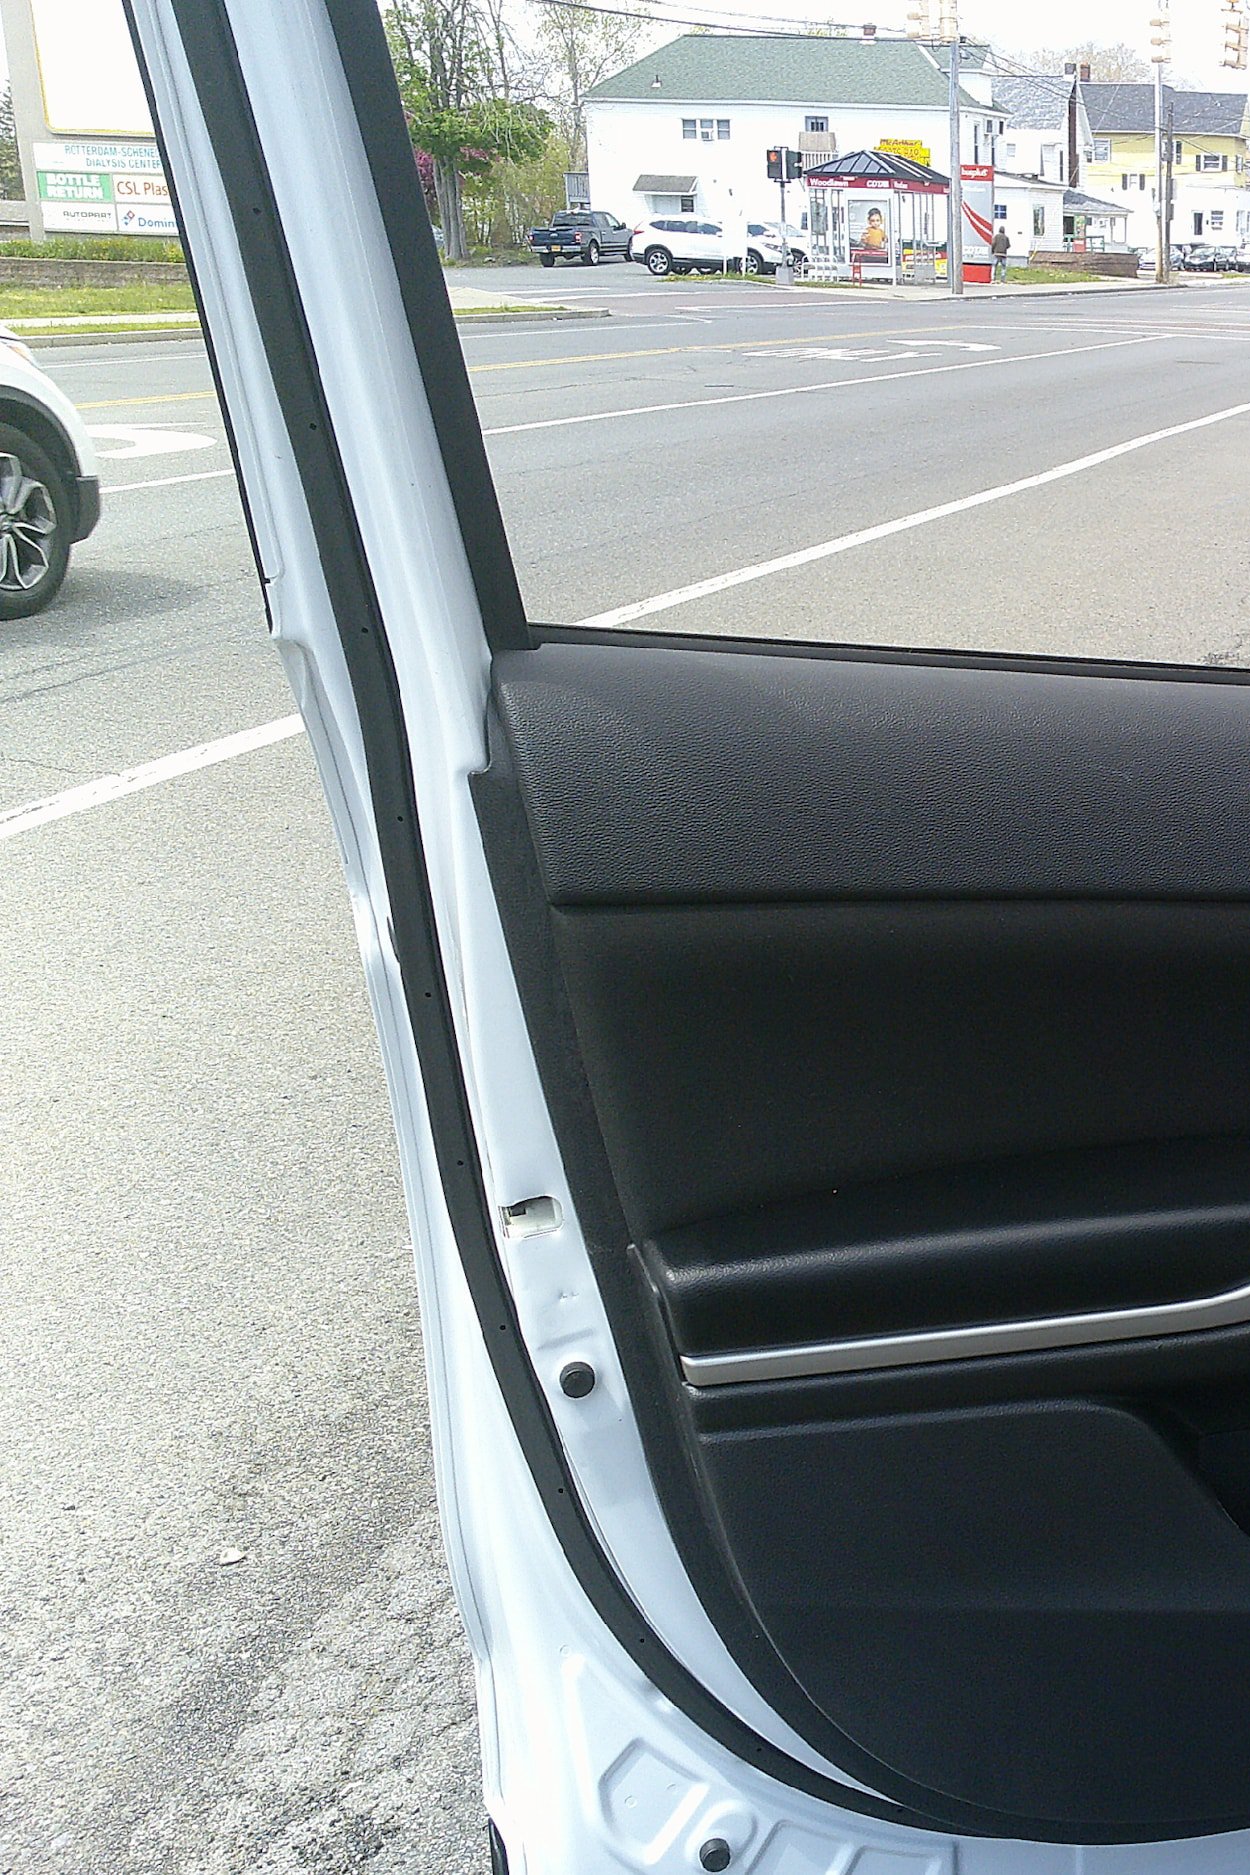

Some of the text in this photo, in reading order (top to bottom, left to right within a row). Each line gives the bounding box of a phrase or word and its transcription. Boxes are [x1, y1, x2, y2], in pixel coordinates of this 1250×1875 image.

[86, 158, 126, 168] DIALYSIS
[45, 173, 100, 186] BOTTLE
[117, 181, 168, 196] CSL Plas
